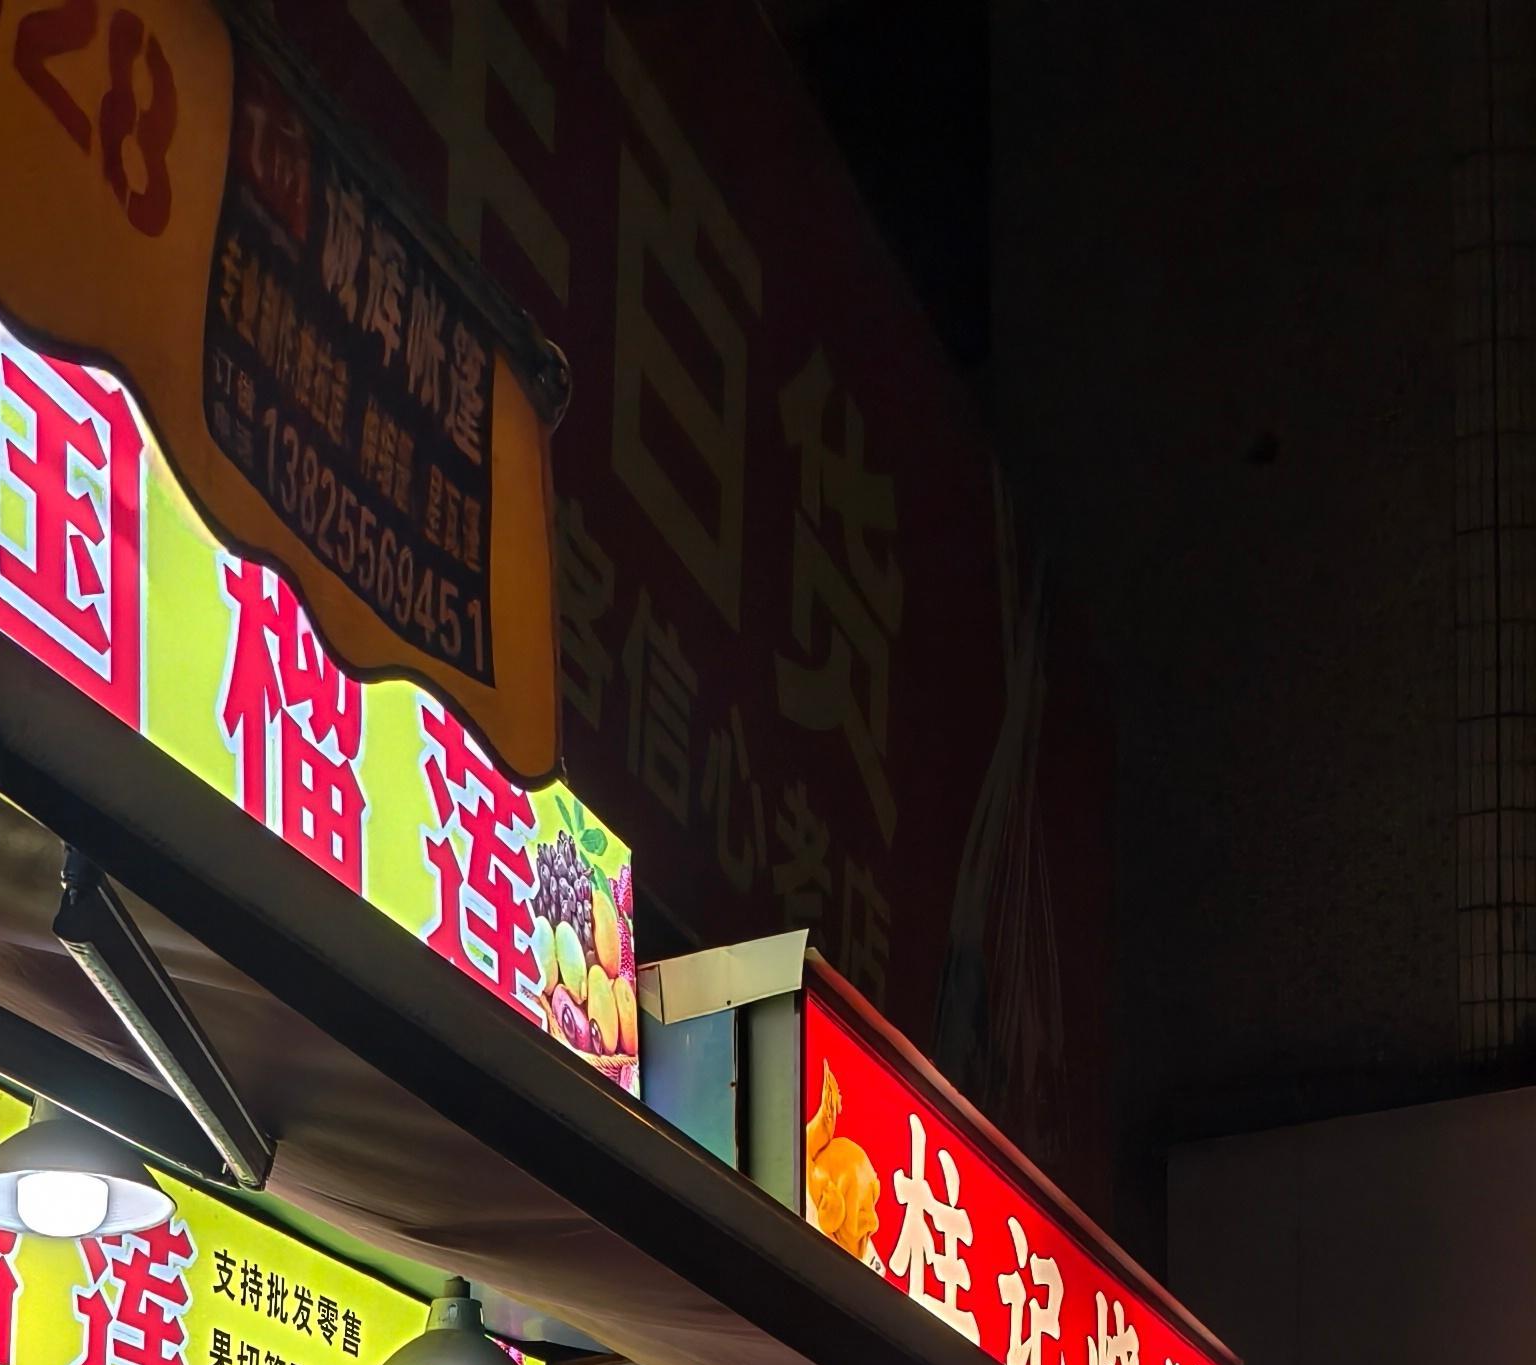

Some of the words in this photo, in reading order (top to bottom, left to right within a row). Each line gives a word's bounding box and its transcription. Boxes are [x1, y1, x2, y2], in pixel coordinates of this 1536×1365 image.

[262, 408, 485, 671] 13825569451
[213, 1250, 362, 1357] 支持批发零售
